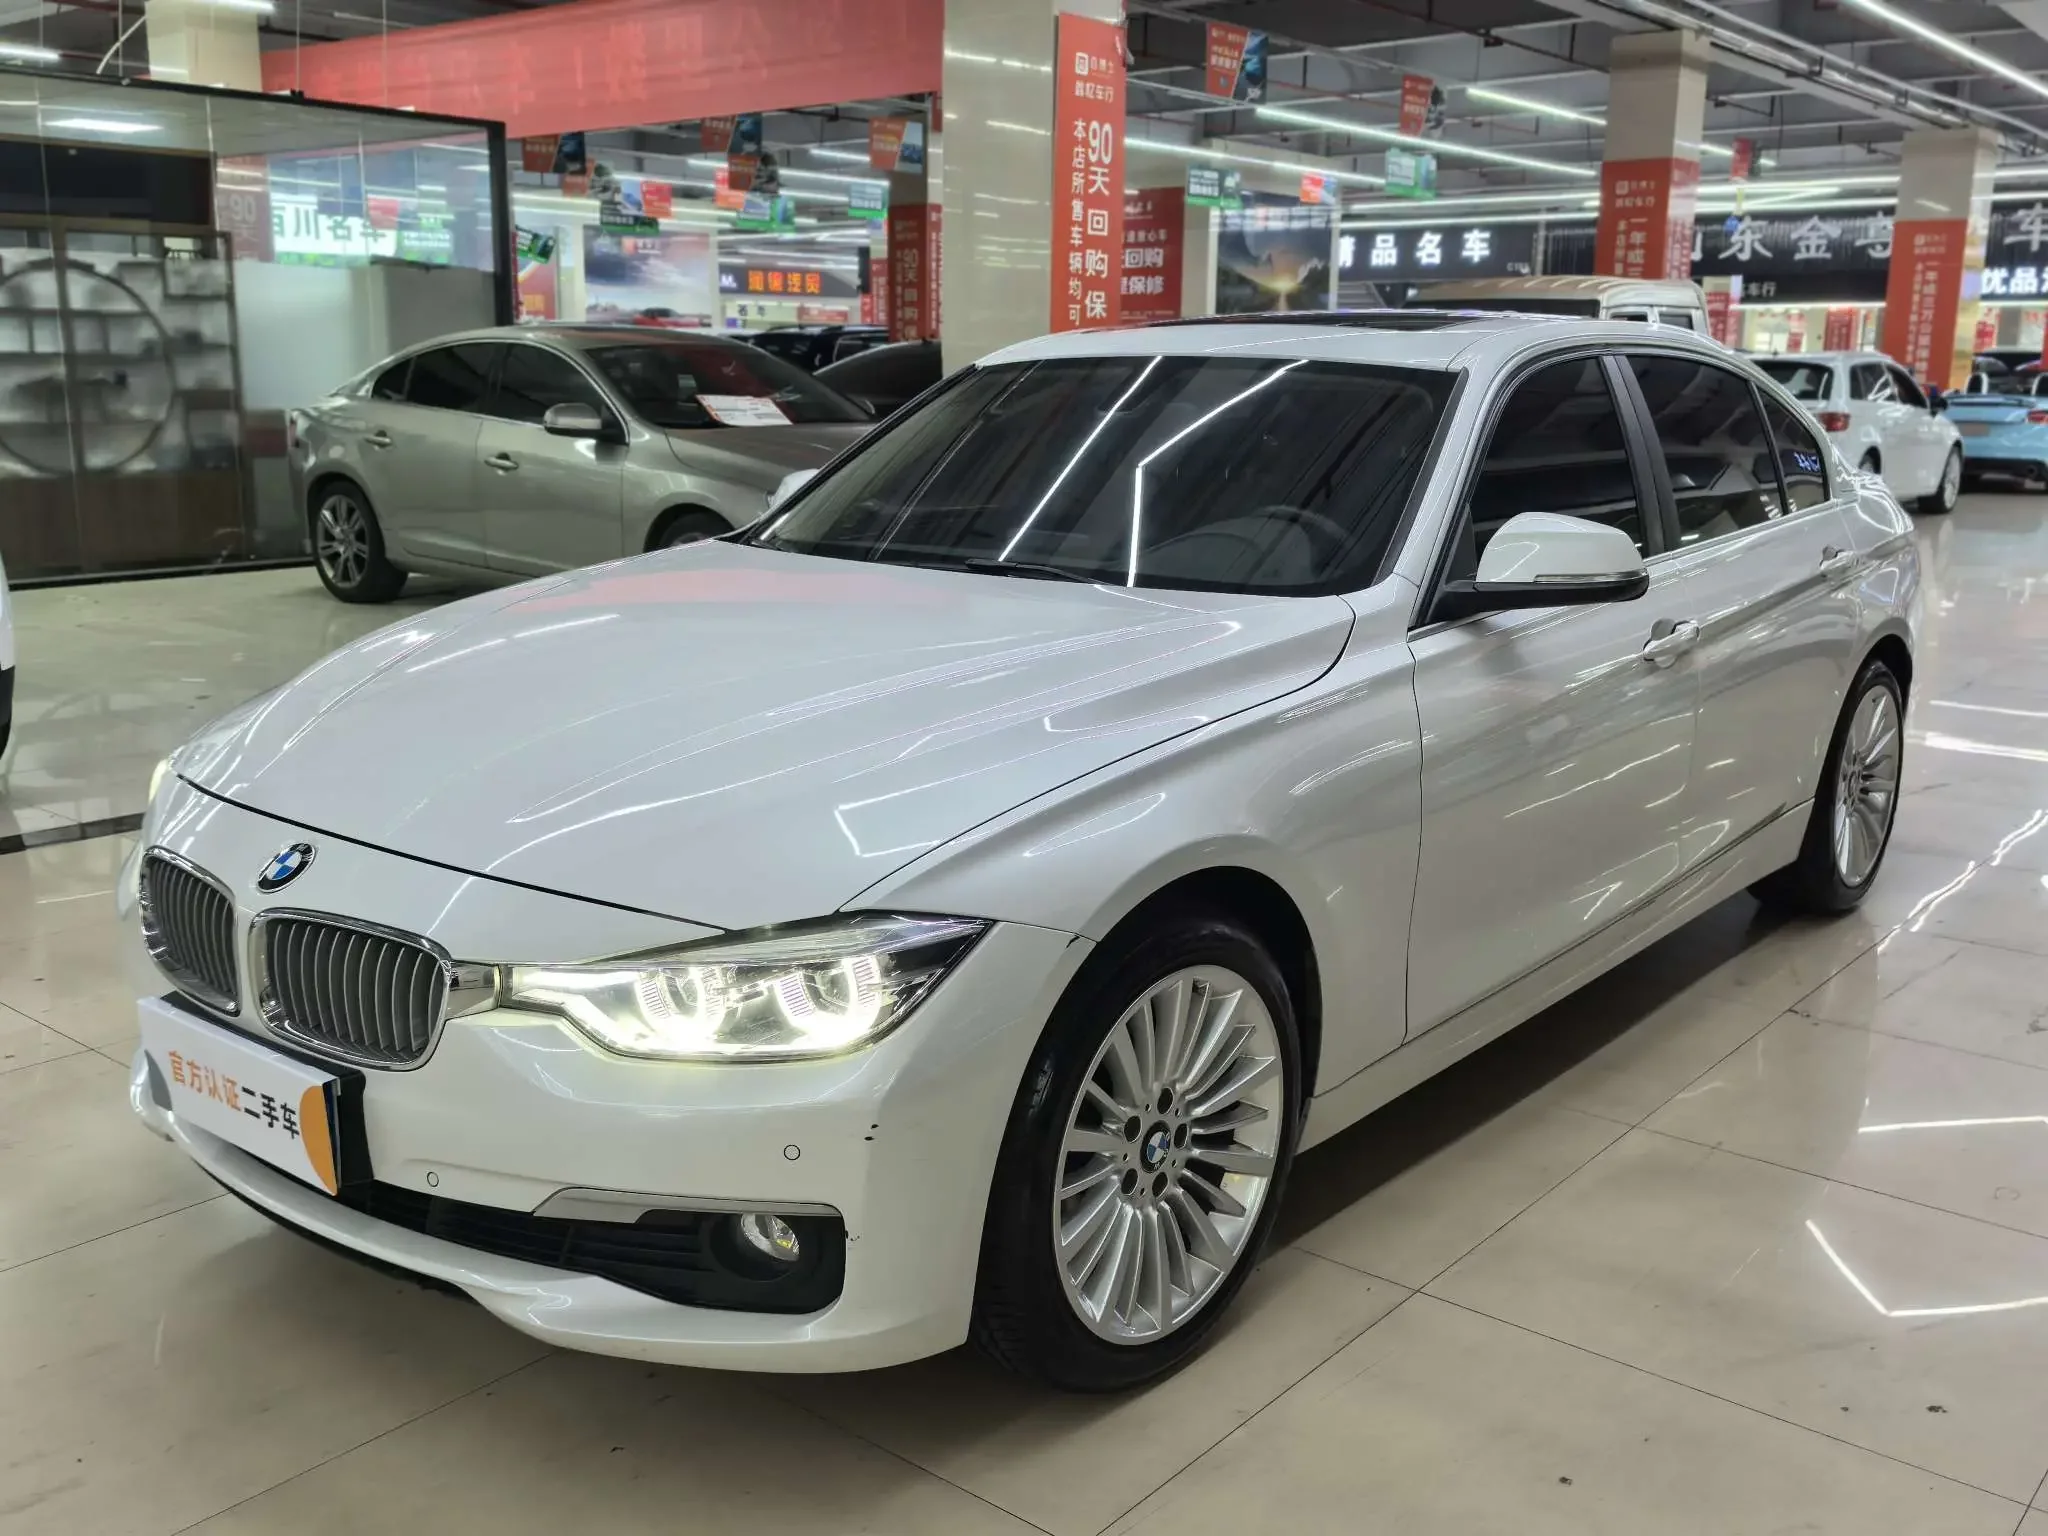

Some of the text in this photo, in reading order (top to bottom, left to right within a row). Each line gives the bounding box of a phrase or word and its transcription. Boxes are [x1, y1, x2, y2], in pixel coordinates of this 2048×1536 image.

[1068, 119, 1086, 326] 本店所售车辆均可
[169, 1050, 300, 1139] 官方认证二手车
